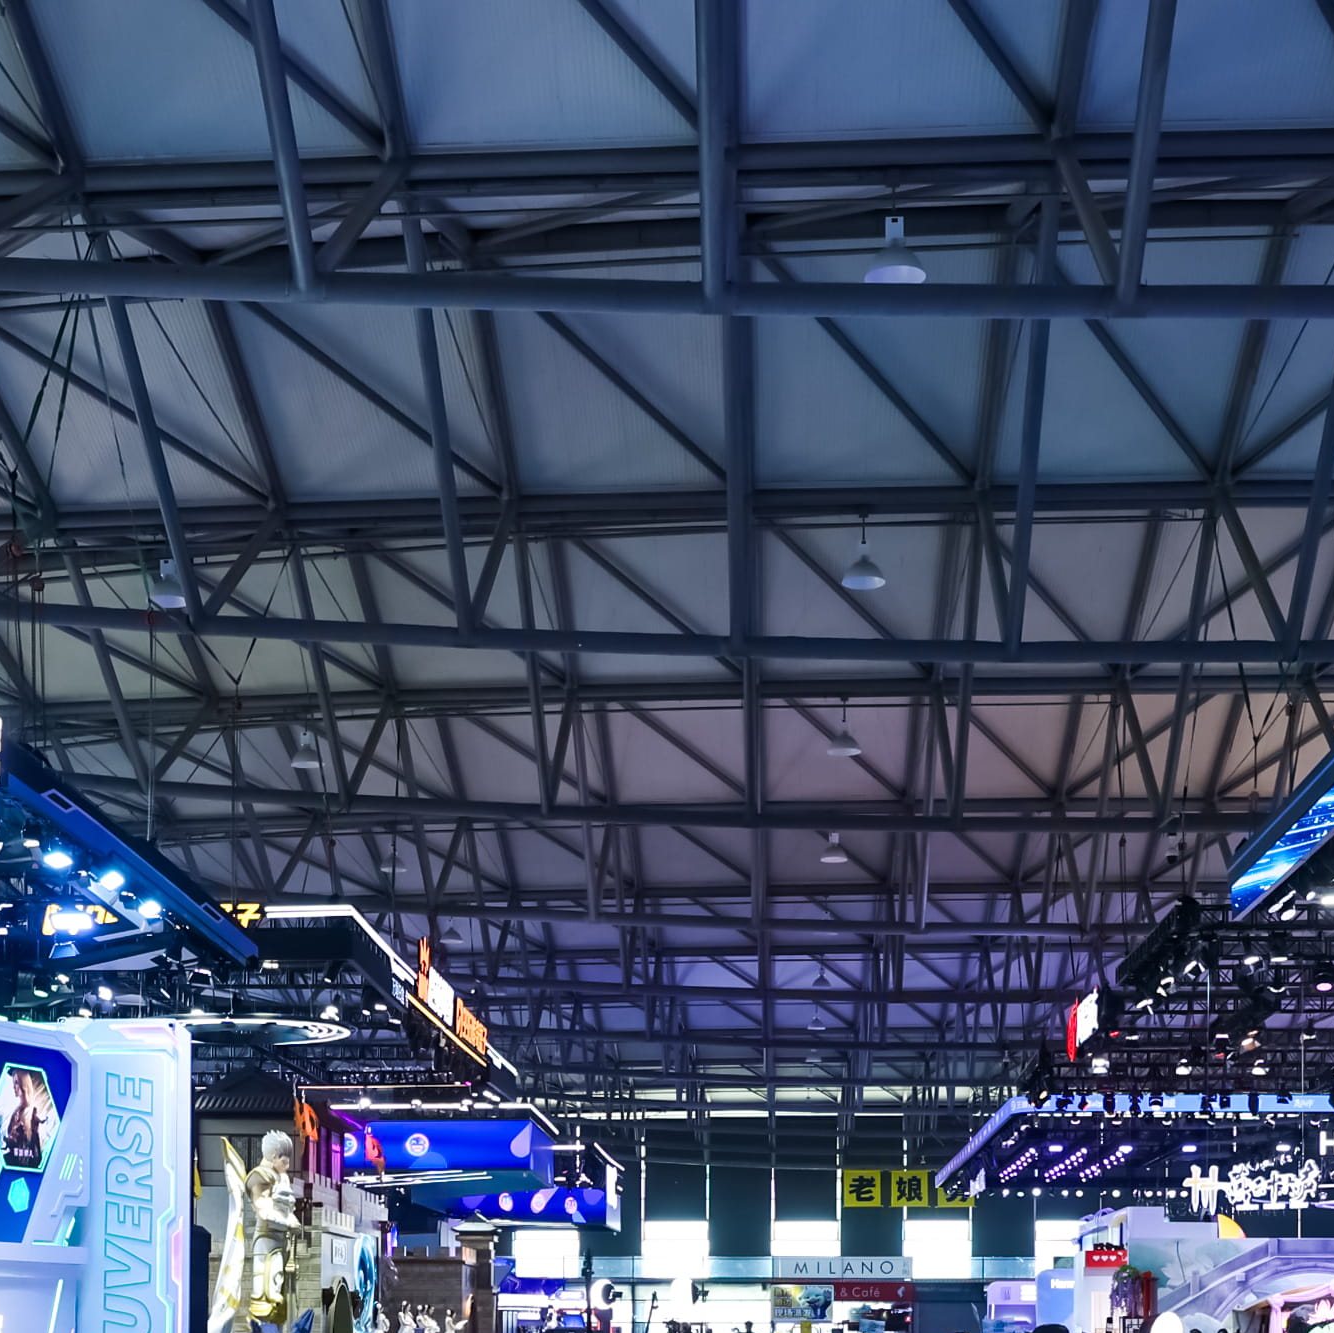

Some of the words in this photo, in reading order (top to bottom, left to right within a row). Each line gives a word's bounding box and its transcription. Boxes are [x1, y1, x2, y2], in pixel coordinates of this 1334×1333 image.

[793, 1260, 895, 1276] MILANO
[840, 1287, 848, 1298] &
[852, 1286, 880, 1298] Café
